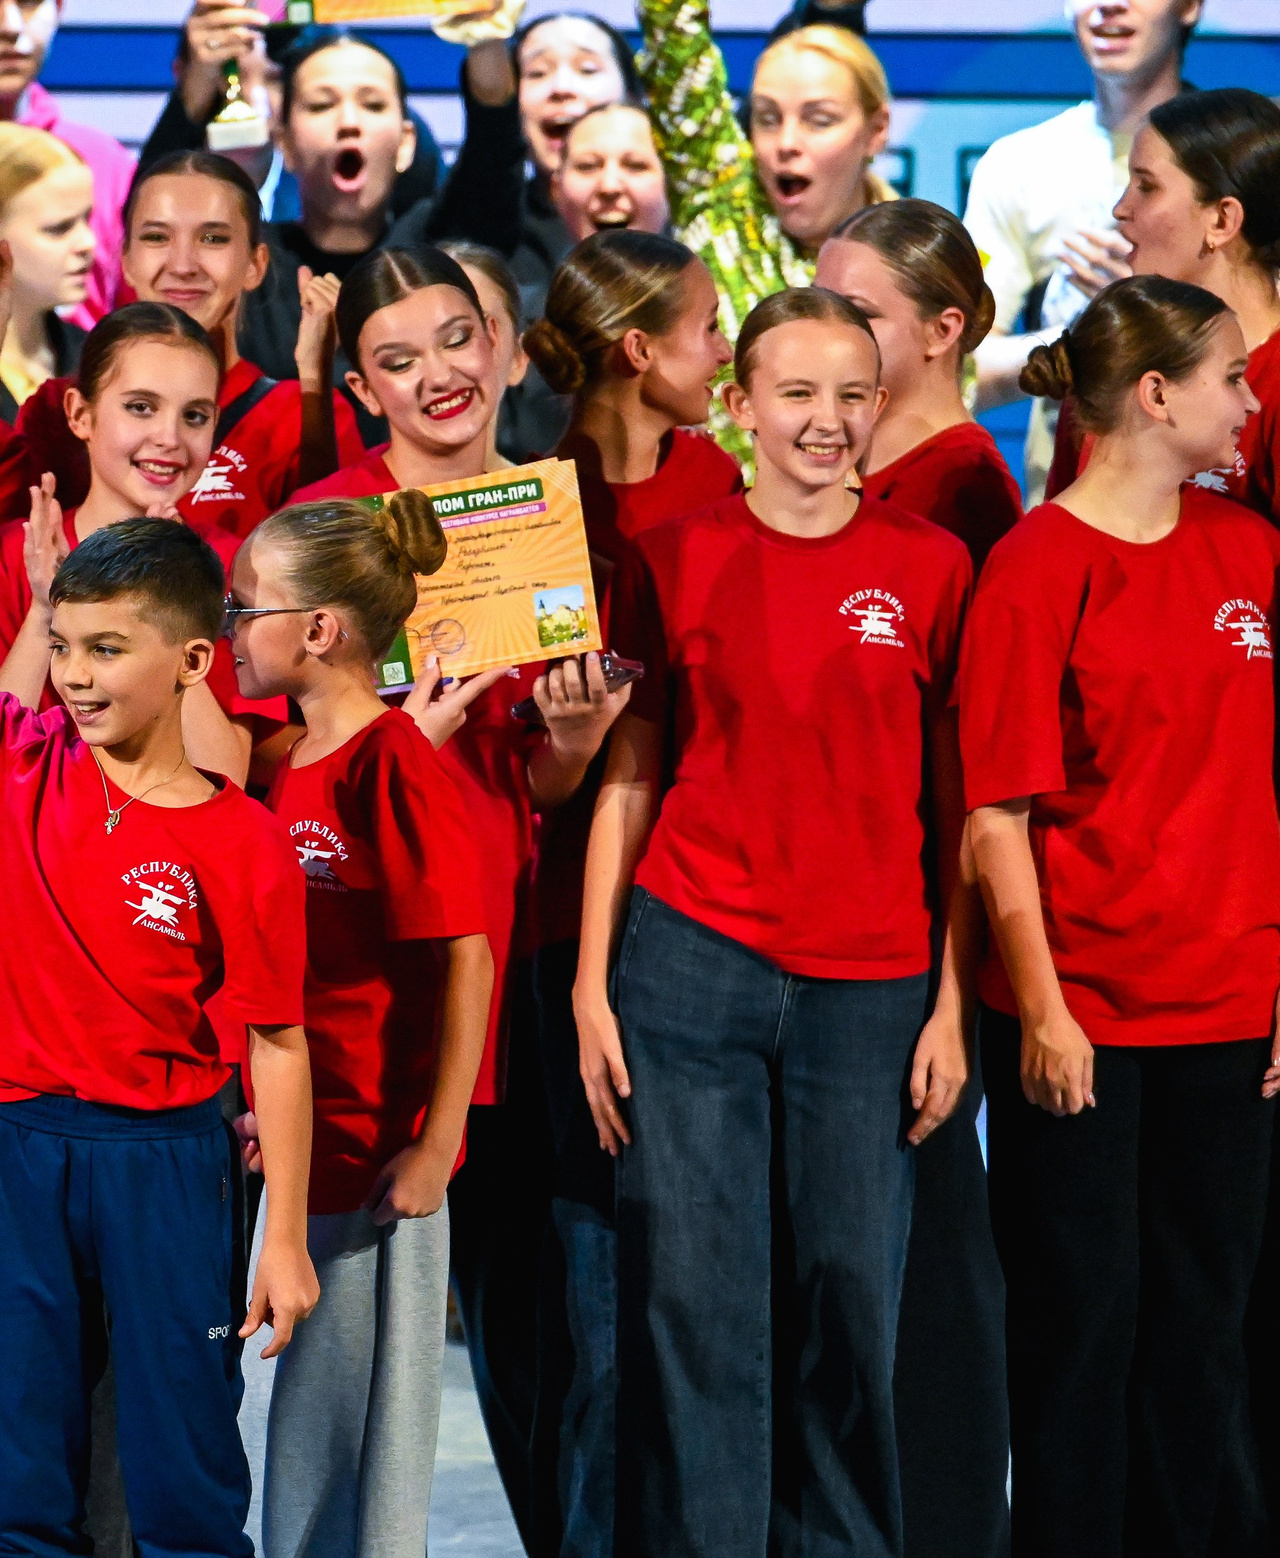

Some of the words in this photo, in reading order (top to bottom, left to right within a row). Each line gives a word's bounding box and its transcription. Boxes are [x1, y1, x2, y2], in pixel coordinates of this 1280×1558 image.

[433, 496, 465, 514] ЛОМ
[467, 483, 537, 508] ГРАН-ПРИ
[289, 820, 349, 862] СПУБЛИКА
[120, 861, 198, 910] РЕСПУБЛИКА
[306, 879, 348, 892] НСАМБЛЬ
[140, 918, 186, 941] АНСАМБЛЬ
